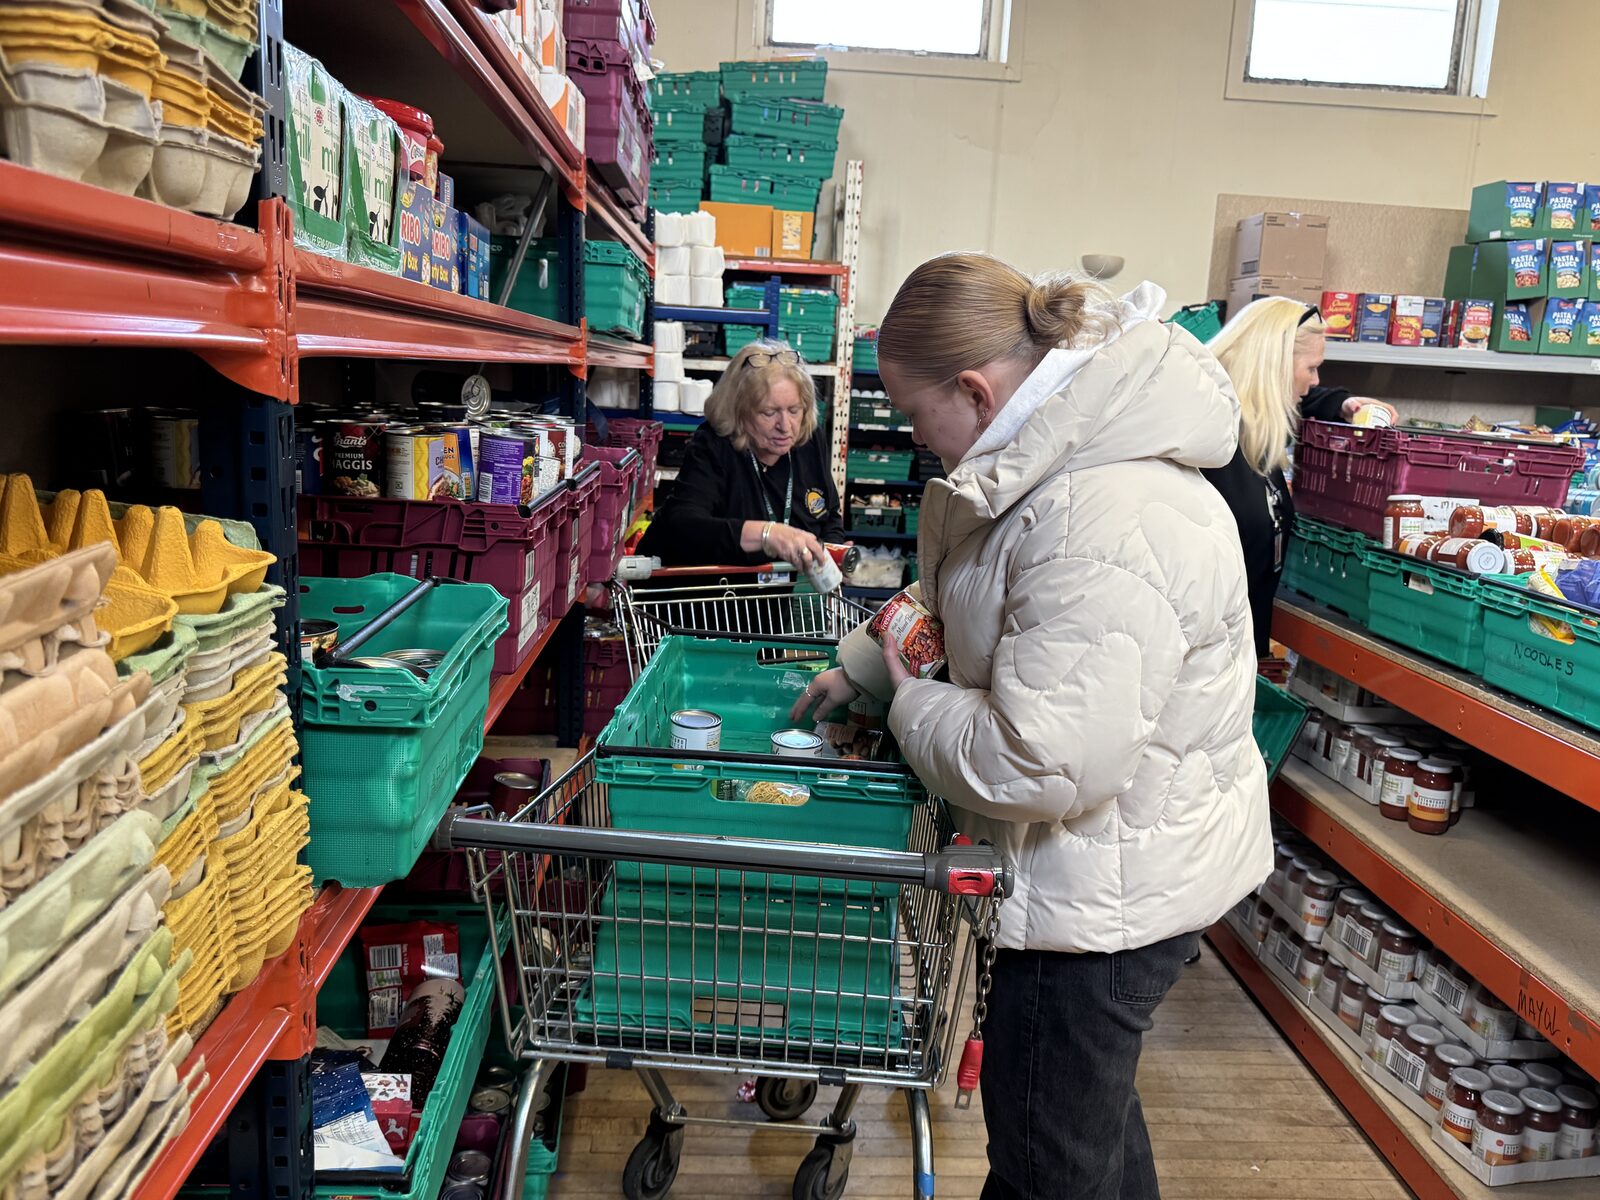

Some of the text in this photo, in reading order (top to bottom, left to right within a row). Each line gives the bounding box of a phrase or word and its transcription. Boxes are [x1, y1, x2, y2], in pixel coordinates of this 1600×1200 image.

[1509, 196, 1527, 205] PASTA
[1549, 196, 1571, 205] PASTA
[1512, 202, 1533, 210] SAUCE
[401, 209, 421, 246] RIBO
[1511, 255, 1532, 265] PASTA
[1514, 260, 1535, 268] SAUCE
[1553, 255, 1574, 265] PASTA
[1552, 312, 1571, 320] PASTA
[1514, 641, 1575, 676] NOODLES
